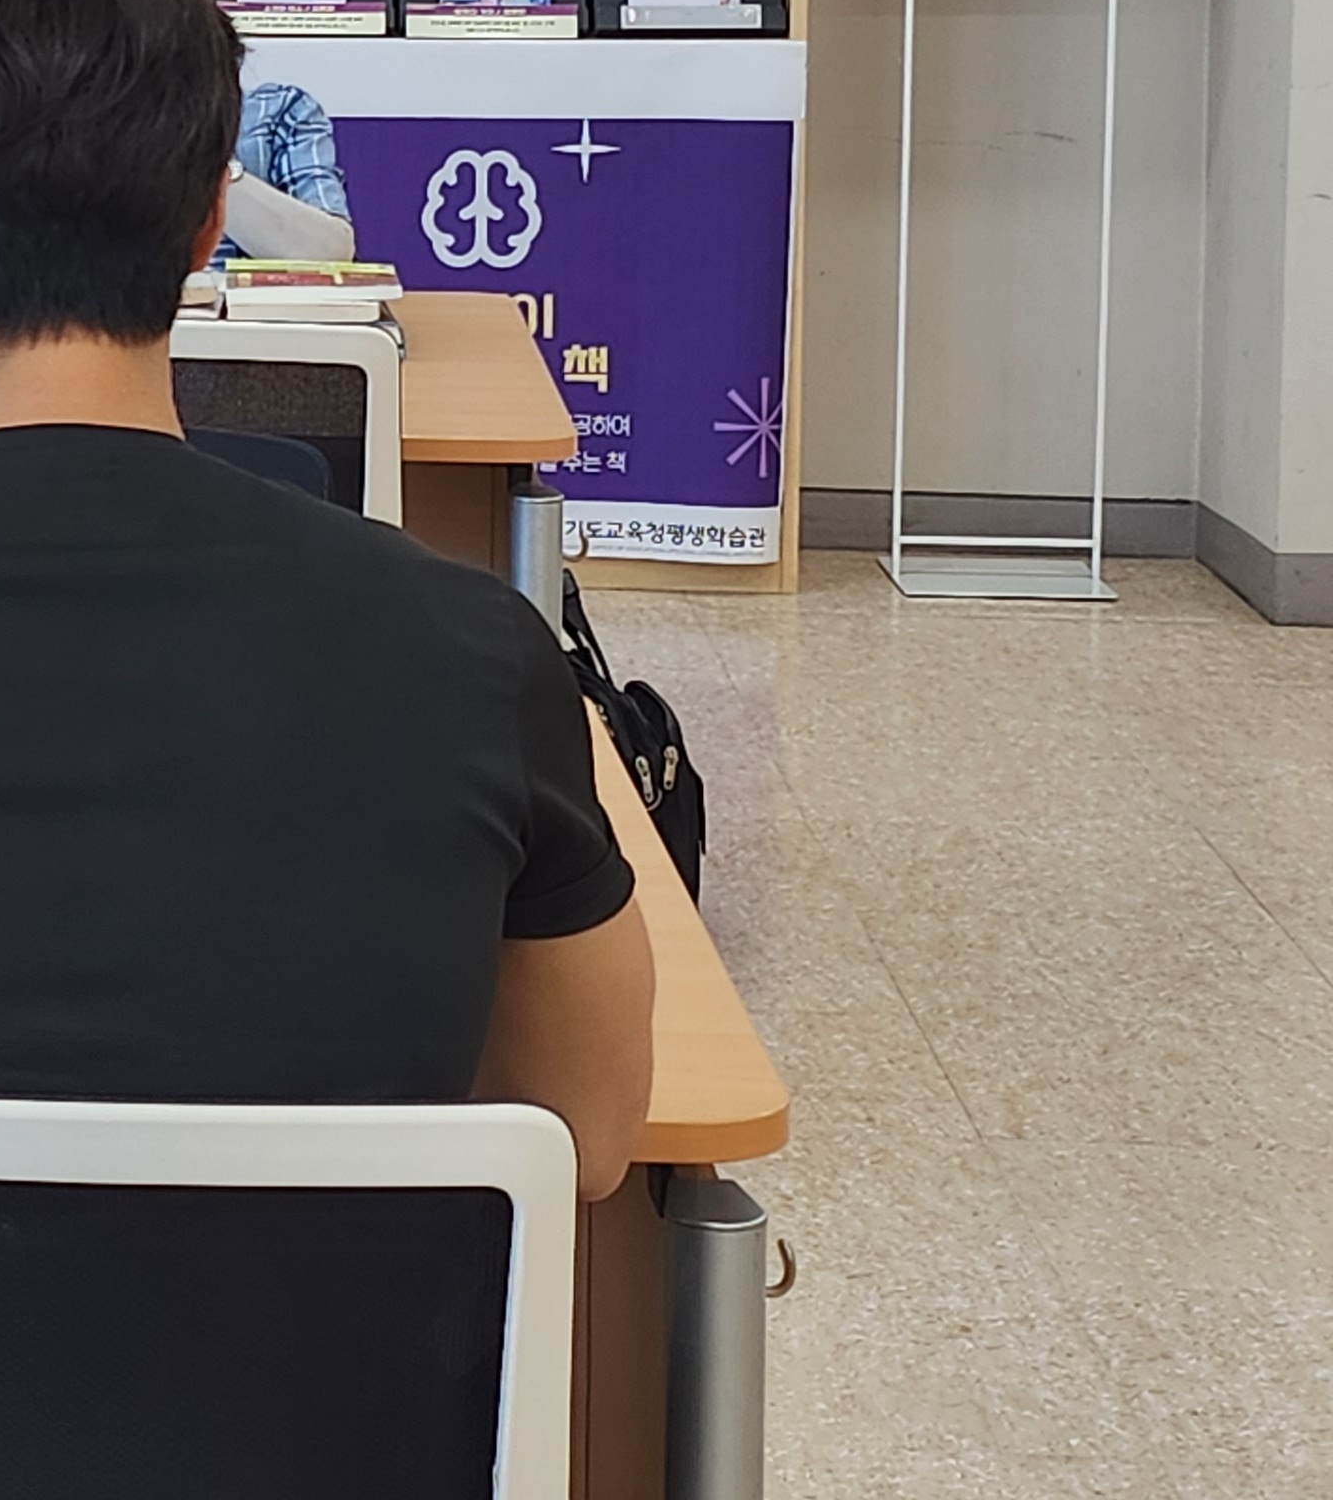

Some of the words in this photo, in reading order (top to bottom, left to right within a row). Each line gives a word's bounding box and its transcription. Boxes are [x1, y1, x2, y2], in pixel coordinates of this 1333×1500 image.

[562, 343, 609, 393] 책
[572, 412, 631, 437] 공하여
[605, 450, 628, 474] 책
[564, 519, 767, 548] 기도교육청평생학습관
